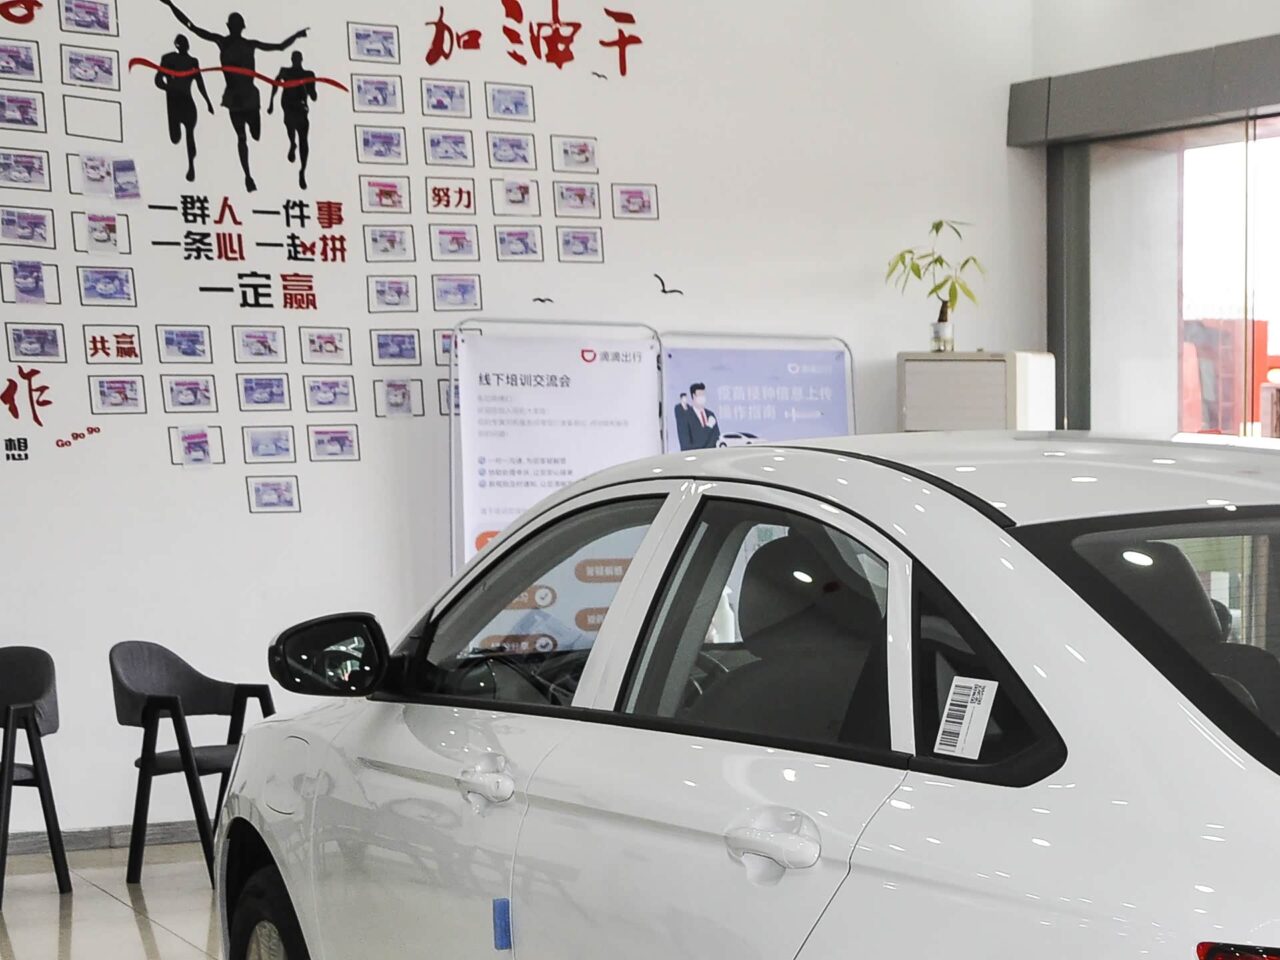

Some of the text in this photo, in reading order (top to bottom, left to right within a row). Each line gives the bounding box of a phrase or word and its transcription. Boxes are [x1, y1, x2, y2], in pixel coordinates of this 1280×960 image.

[424, 0, 643, 76] 加油干
[147, 194, 345, 229] 一群人 一件事
[431, 187, 472, 209] 努力
[151, 230, 246, 261] 一条心
[199, 271, 318, 310] 一定赢
[88, 332, 139, 360] 共赢
[600, 351, 642, 363] 滴滴出行
[478, 372, 571, 388] 线下培训交流会
[0, 365, 53, 427] 作
[4, 437, 28, 461] 想
[56, 426, 101, 448] Go go go
